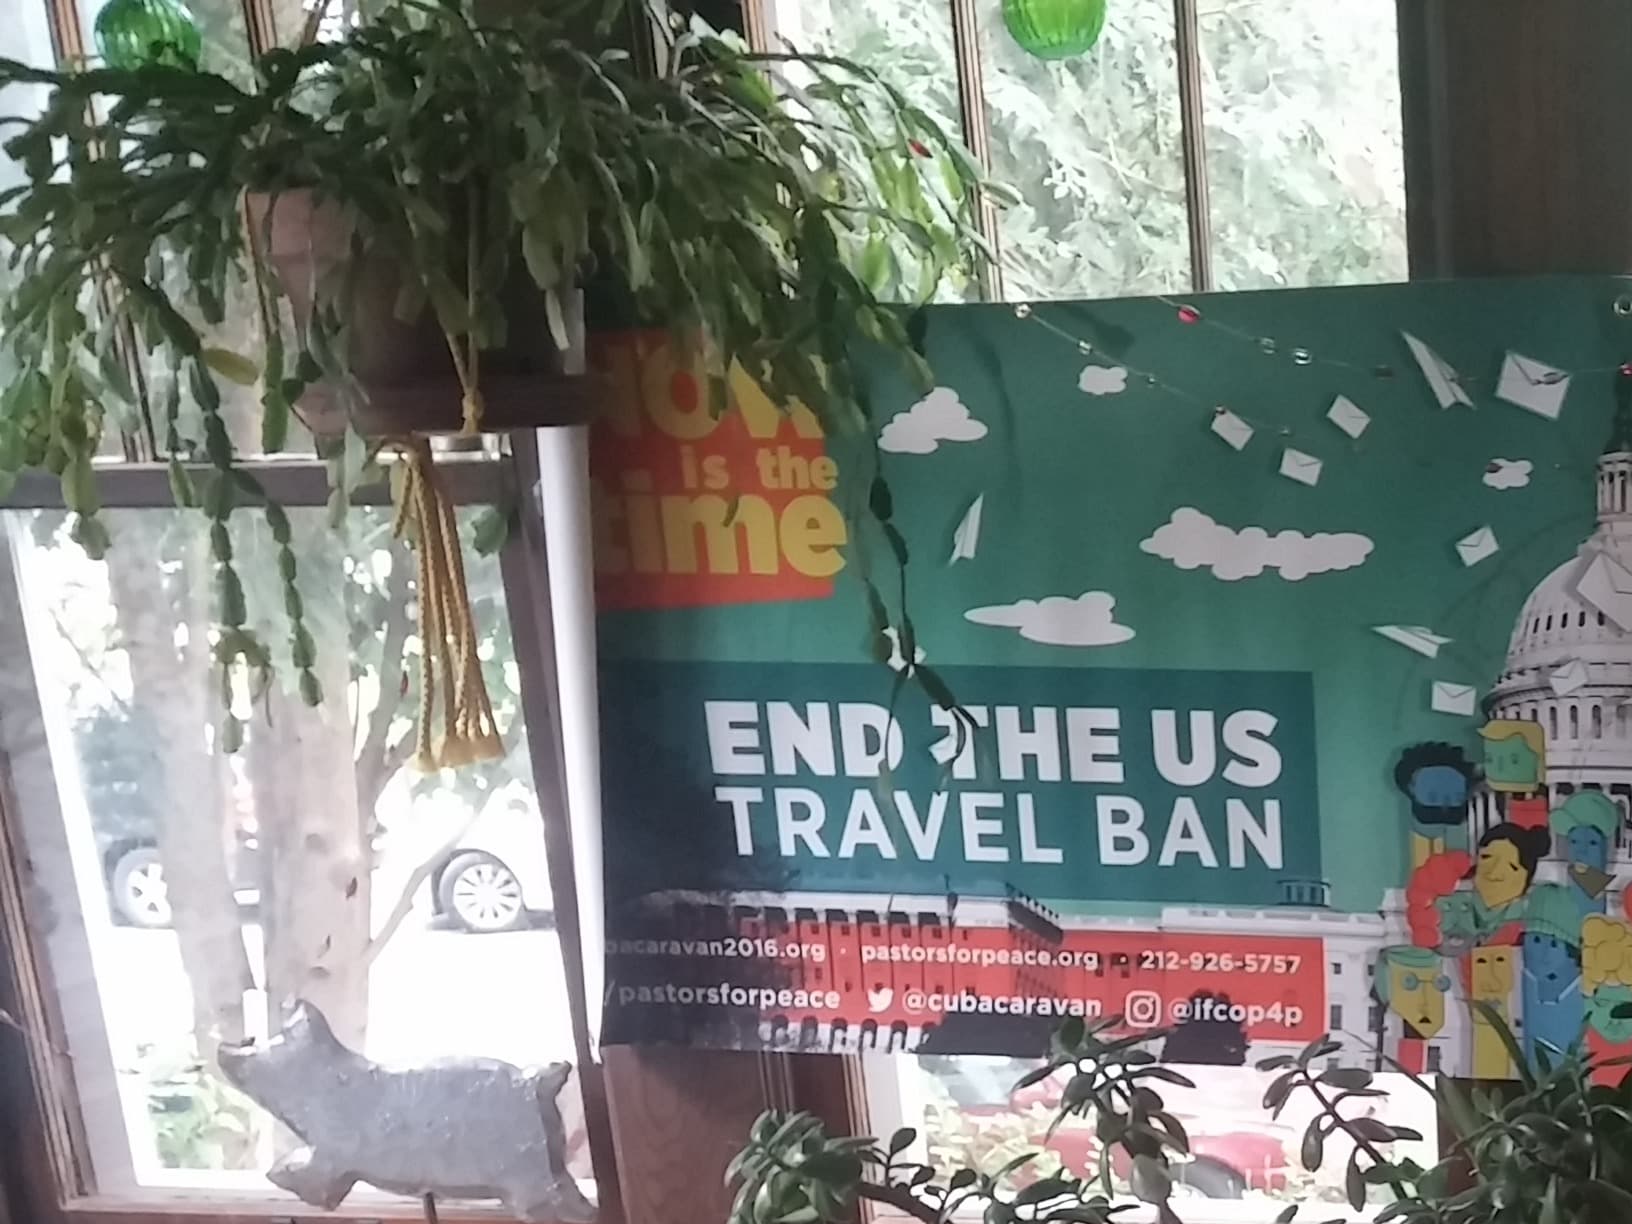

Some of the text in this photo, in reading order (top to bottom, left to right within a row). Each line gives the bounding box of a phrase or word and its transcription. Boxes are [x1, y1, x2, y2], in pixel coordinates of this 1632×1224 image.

[680, 446, 839, 490] is the
[704, 700, 1282, 788] END THE US
[714, 787, 1284, 870] TRAVEL BAN
[861, 942, 1099, 972] pastorsforpeace.org
[1142, 949, 1302, 975] 212-926-5757
[901, 984, 1102, 1018] @cubacaravan
[1169, 998, 1303, 1028] @ifcop4p
